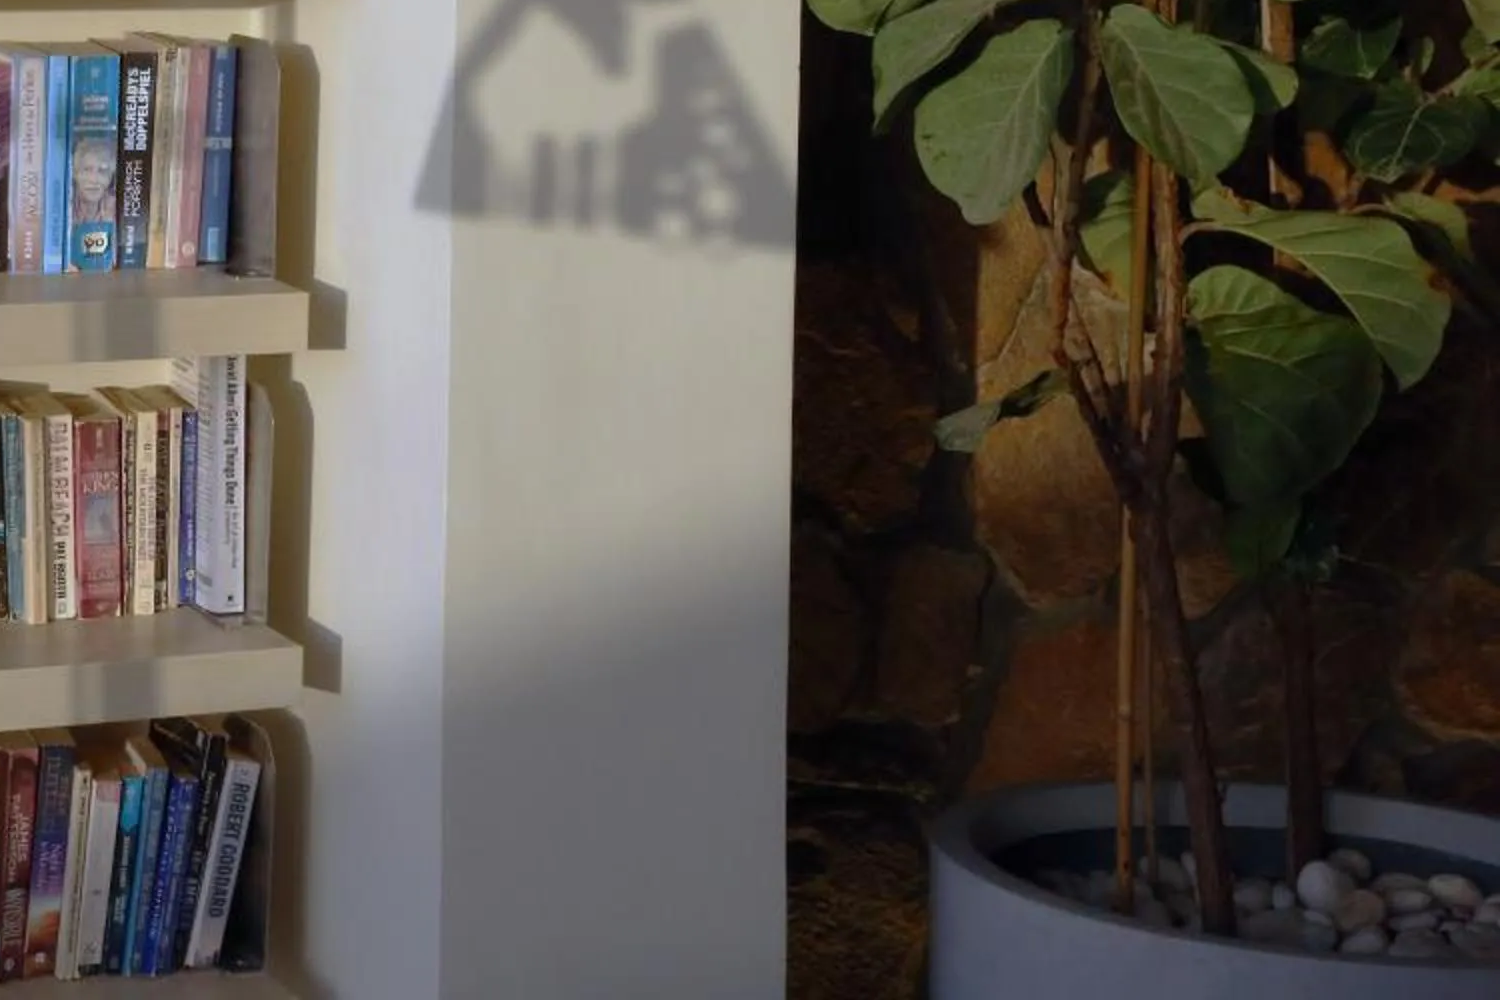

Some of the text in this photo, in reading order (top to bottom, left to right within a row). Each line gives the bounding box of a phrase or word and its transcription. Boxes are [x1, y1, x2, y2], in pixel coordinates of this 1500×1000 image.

[123, 67, 140, 151] McCREADYS
[135, 67, 151, 150] DOPPELSPIEL
[223, 409, 238, 445] Getting
[224, 447, 238, 478] Things
[225, 481, 238, 505] Done
[18, 813, 30, 863] JAMES
[208, 782, 251, 918] ROBERT GODDARD
